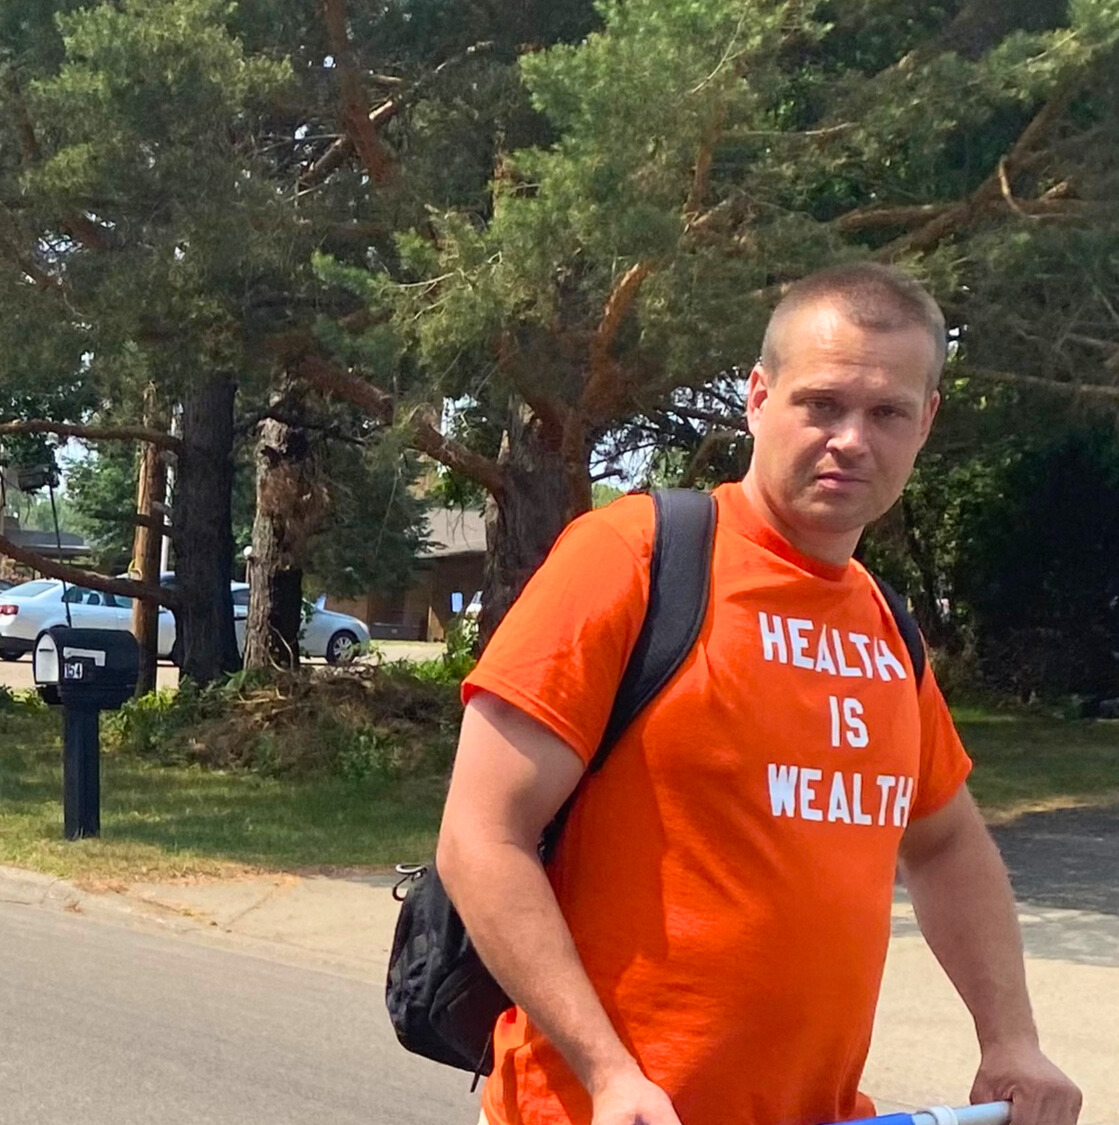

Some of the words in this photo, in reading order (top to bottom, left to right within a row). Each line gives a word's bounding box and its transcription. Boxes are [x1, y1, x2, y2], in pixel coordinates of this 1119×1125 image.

[758, 611, 907, 682] HEALTH
[829, 695, 869, 748] IS
[768, 763, 914, 828] WEALTH
